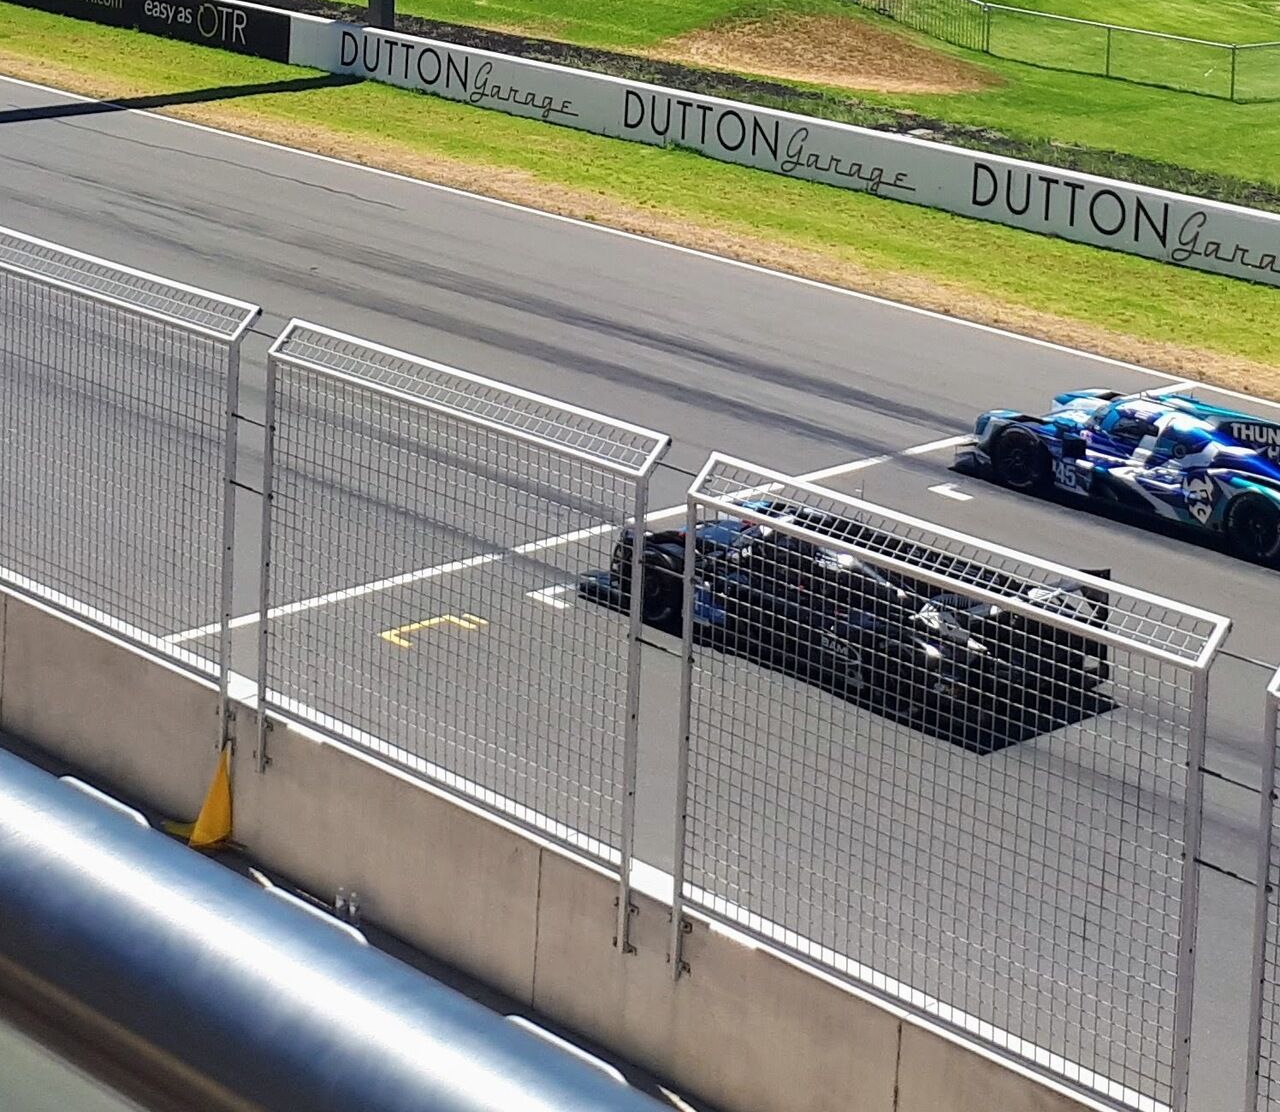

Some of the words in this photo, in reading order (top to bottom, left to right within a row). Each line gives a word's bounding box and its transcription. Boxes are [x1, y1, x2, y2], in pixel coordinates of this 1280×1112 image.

[144, 0, 175, 25] easy
[176, 6, 192, 24] as
[197, 2, 247, 45] OTR
[341, 31, 469, 92] DUTTON
[470, 61, 579, 118] Garage
[623, 90, 779, 161] DUTTON
[780, 127, 916, 193] Garage
[971, 162, 1169, 249] DUTTON
